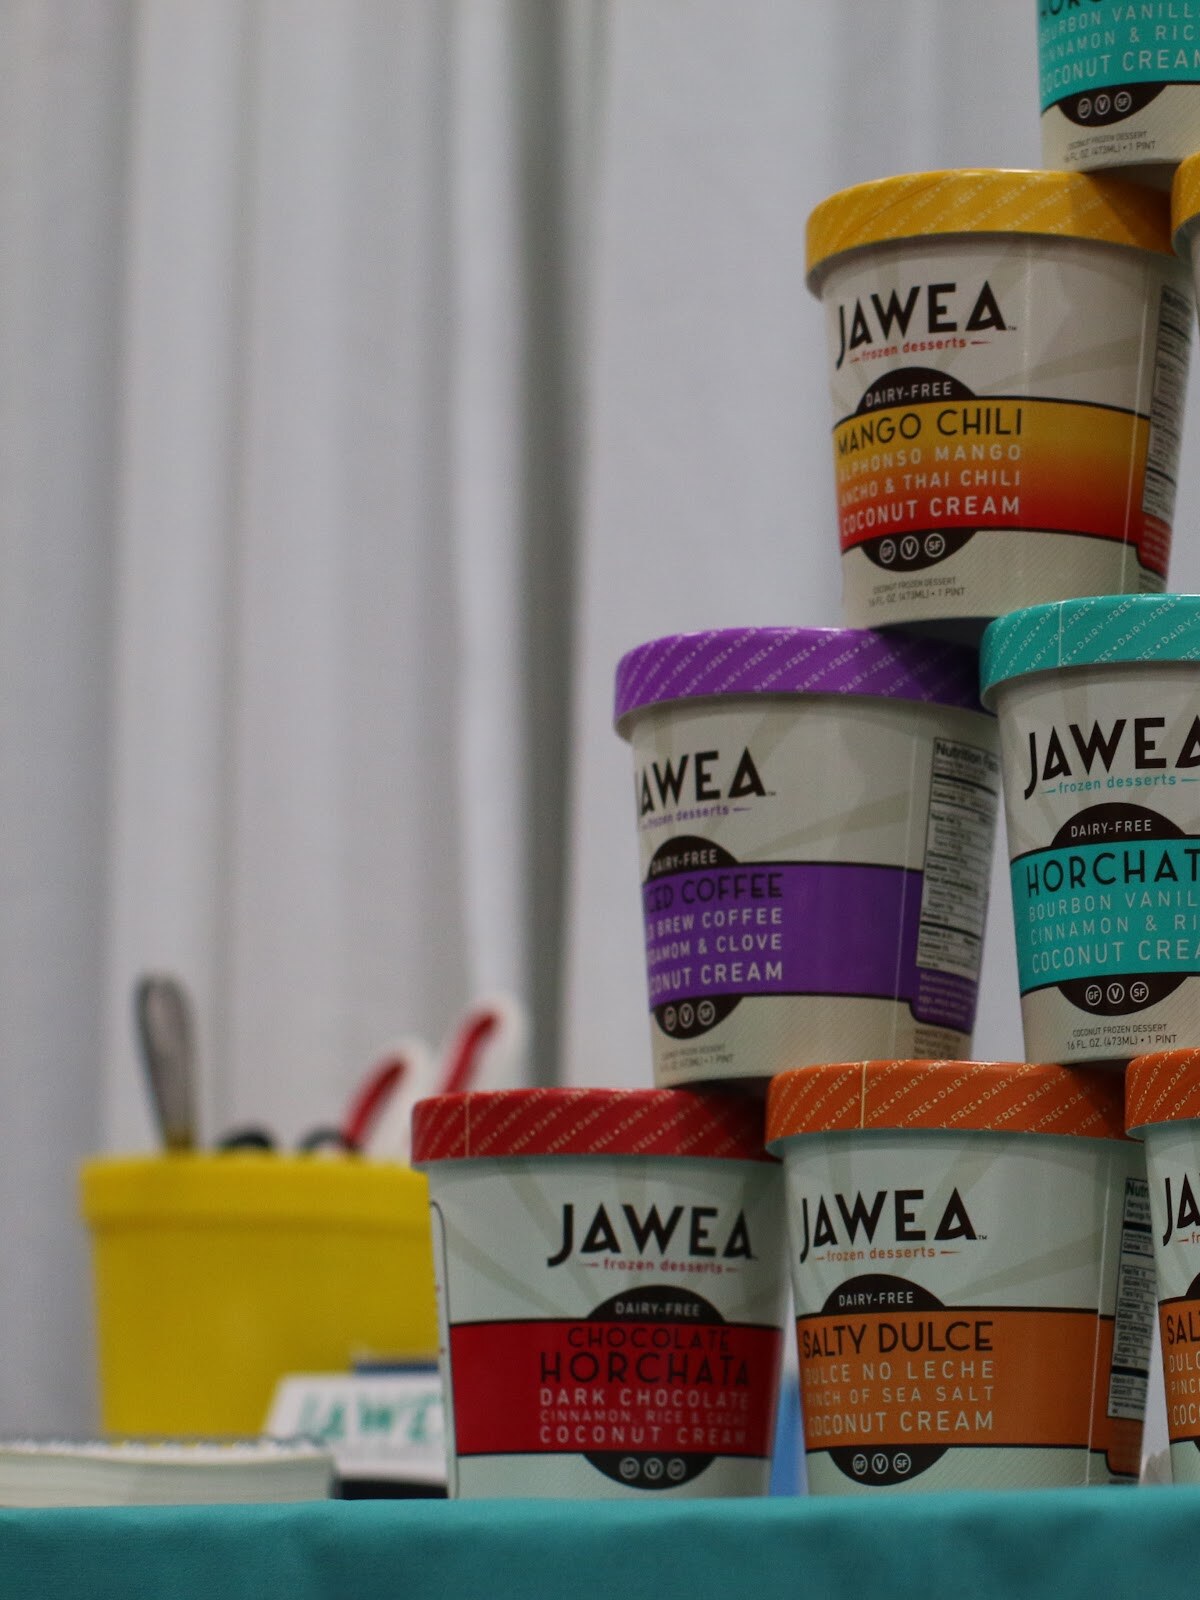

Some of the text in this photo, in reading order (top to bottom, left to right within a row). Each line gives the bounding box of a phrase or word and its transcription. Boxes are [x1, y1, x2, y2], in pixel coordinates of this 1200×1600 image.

[836, 280, 1007, 370] JAWEA
[903, 337, 966, 354] desserts
[866, 381, 952, 408] DAIRY-FREE
[839, 408, 1023, 457] MANGO CHILI
[935, 444, 1021, 462] MANGO
[904, 469, 1020, 489] THAI CHILI
[842, 497, 1019, 537] COCONUT CREAM
[1058, 773, 1177, 794] frozen desserts
[1070, 820, 1152, 837] DAIRY-FREE
[681, 873, 783, 904] COFFEE
[702, 908, 783, 926] COFFEE
[1029, 895, 1112, 922] BOURBON
[1031, 917, 1128, 946] CINNAMON
[1146, 916, 1156, 931] &
[716, 935, 783, 952] CLOVE
[1032, 942, 1122, 974] COCONUT
[702, 962, 783, 982] CREAM
[1103, 1024, 1131, 1034] FROZEN
[1134, 1023, 1167, 1032] DESSERT
[1105, 1035, 1138, 1047] (473ML)
[1155, 1034, 1176, 1044] PINT
[547, 1202, 753, 1268] JAWEA
[800, 1186, 977, 1264] JAWEA
[827, 1246, 935, 1262] frozen desserts
[604, 1258, 722, 1274] frozen desserts
[615, 1302, 700, 1316] DAIRY-FREE
[839, 1291, 914, 1306] DAIRY-FREE
[568, 1328, 731, 1352] CHOCOLATE
[803, 1321, 993, 1358] SALTY DULCE
[541, 1352, 749, 1386] HORCHATA
[807, 1361, 993, 1385] DULCE NO LECHE
[541, 1388, 748, 1410] DARK CHOCOLATE
[851, 1386, 993, 1404] OF SEA SALT
[541, 1426, 661, 1443] COCONUT
[809, 1411, 993, 1438] COCONUT CREAM
